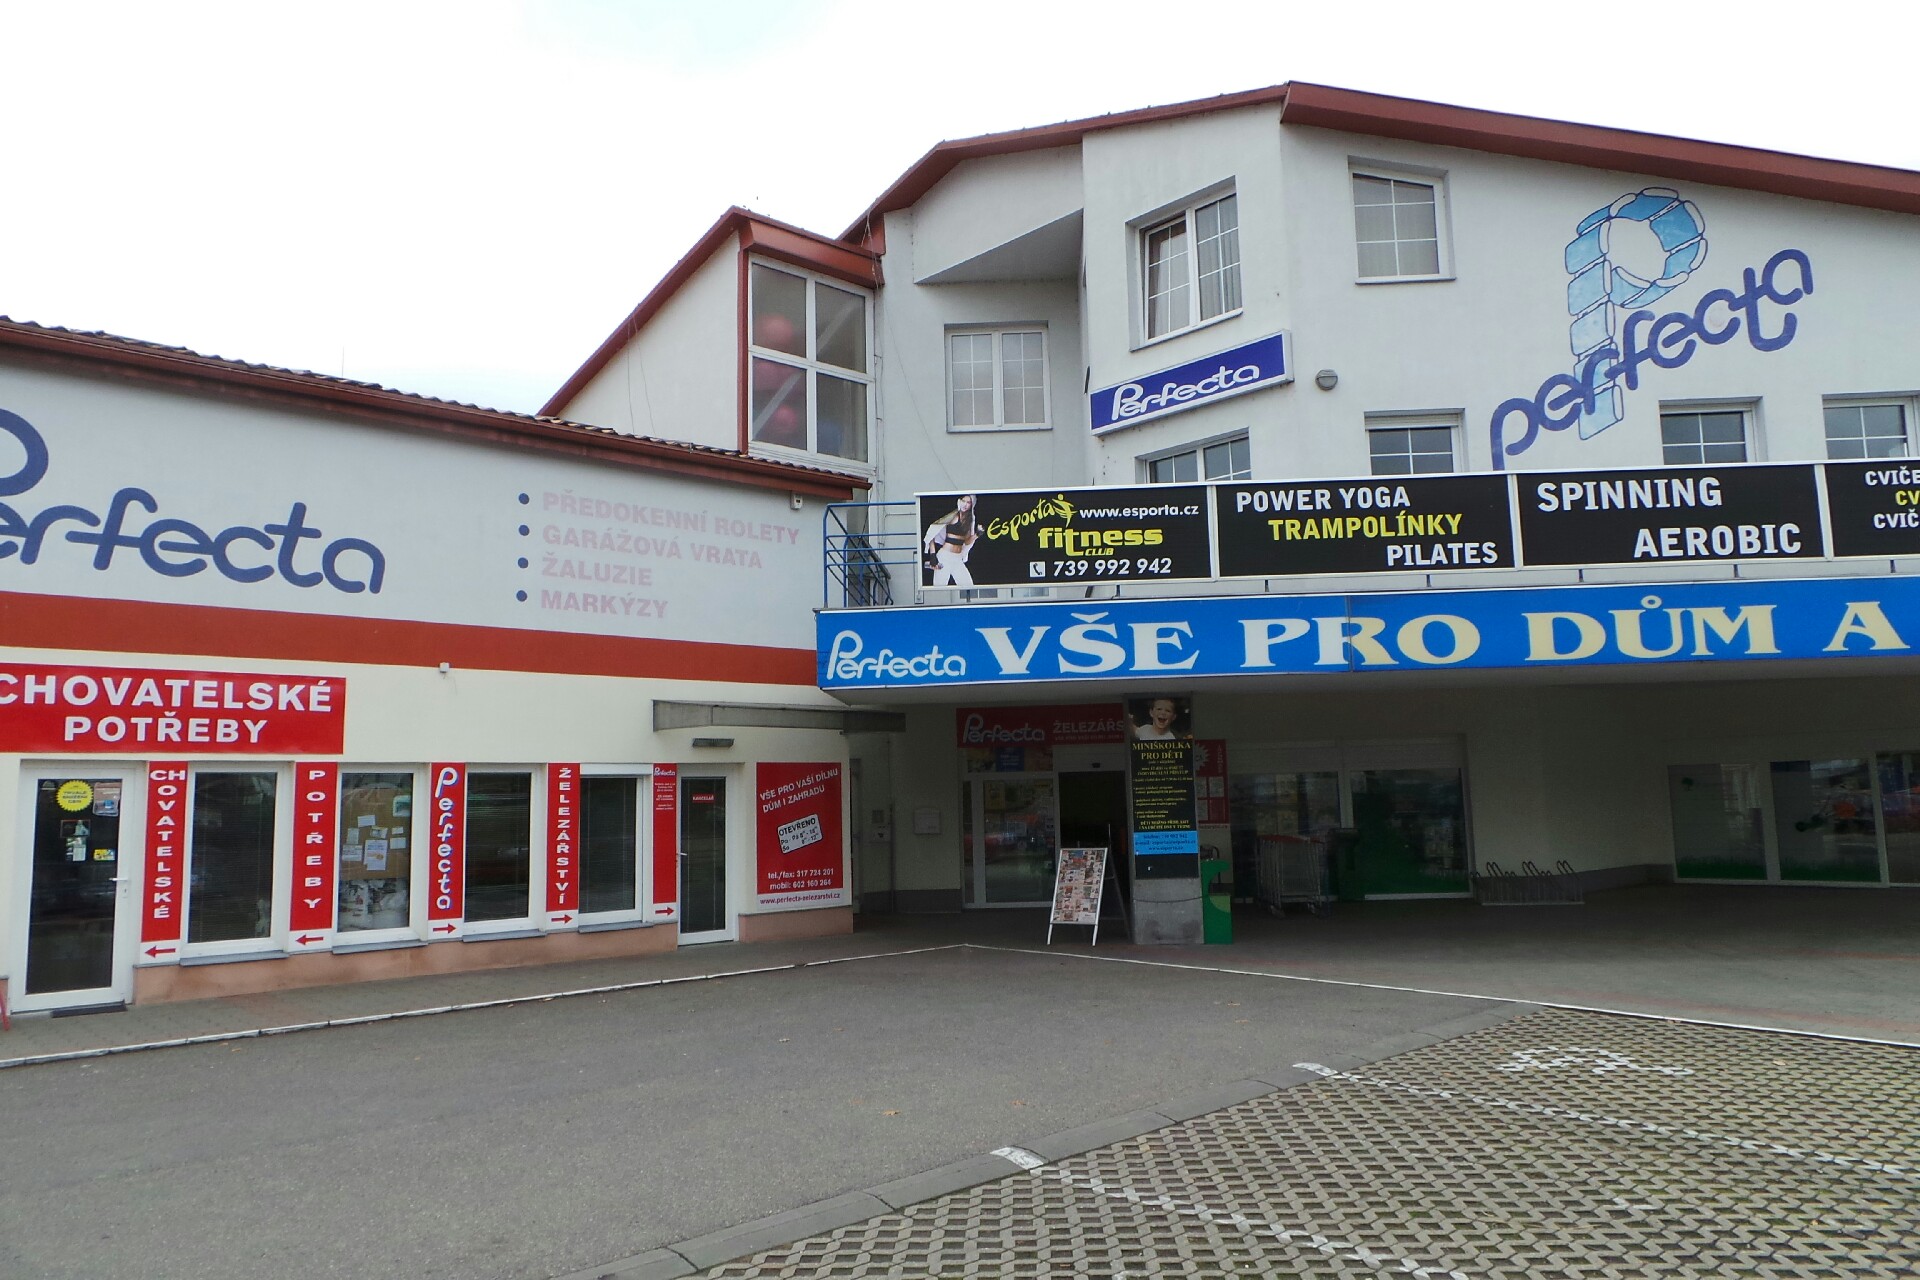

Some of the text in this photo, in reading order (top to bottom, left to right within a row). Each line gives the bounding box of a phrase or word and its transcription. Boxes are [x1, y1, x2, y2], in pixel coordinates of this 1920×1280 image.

[1111, 365, 1260, 420] Perfecta
[1236, 486, 1410, 512] POWER YOGA
[1537, 477, 1723, 512] SPINNING
[542, 489, 799, 545] PŘEDOKENNÍ ROLETY
[986, 498, 1056, 541] Esporta
[1079, 505, 1199, 519] www.esporta.cz
[1268, 510, 1462, 540] TRAMPOLÍNKY
[542, 524, 762, 568] GARÁŽOVÁ VRATA
[1038, 527, 1163, 557] fitness
[1085, 547, 1115, 556] CLUB
[1387, 542, 1498, 566] PILATES
[1634, 523, 1802, 558] AEROBIC
[541, 551, 653, 586] ŽALUZIE
[1053, 558, 1172, 576] 739 992 942
[540, 589, 668, 619] MARKÝZY
[827, 594, 1911, 680] Perfecta VŠE PRO DŮM A
[64, 711, 268, 743] POTŘEBY
[962, 713, 1045, 743] Perfecta
[1132, 741, 1191, 750] MINIŠKOLKA
[1141, 751, 1160, 760] PRO
[760, 789, 777, 801] VŠE
[777, 783, 795, 798] PRO
[815, 768, 838, 782] DÍLNU
[782, 798, 787, 806] I
[787, 784, 825, 805] ZAHRADU
[149, 769, 186, 919] CHOVATELSKÉ
[303, 769, 326, 909] POTŘEBY
[435, 767, 459, 910] Perfecta
[555, 767, 572, 905] ŽELEZÁŘSTVÍ
[796, 869, 808, 878] 317
[822, 867, 834, 876] 201
